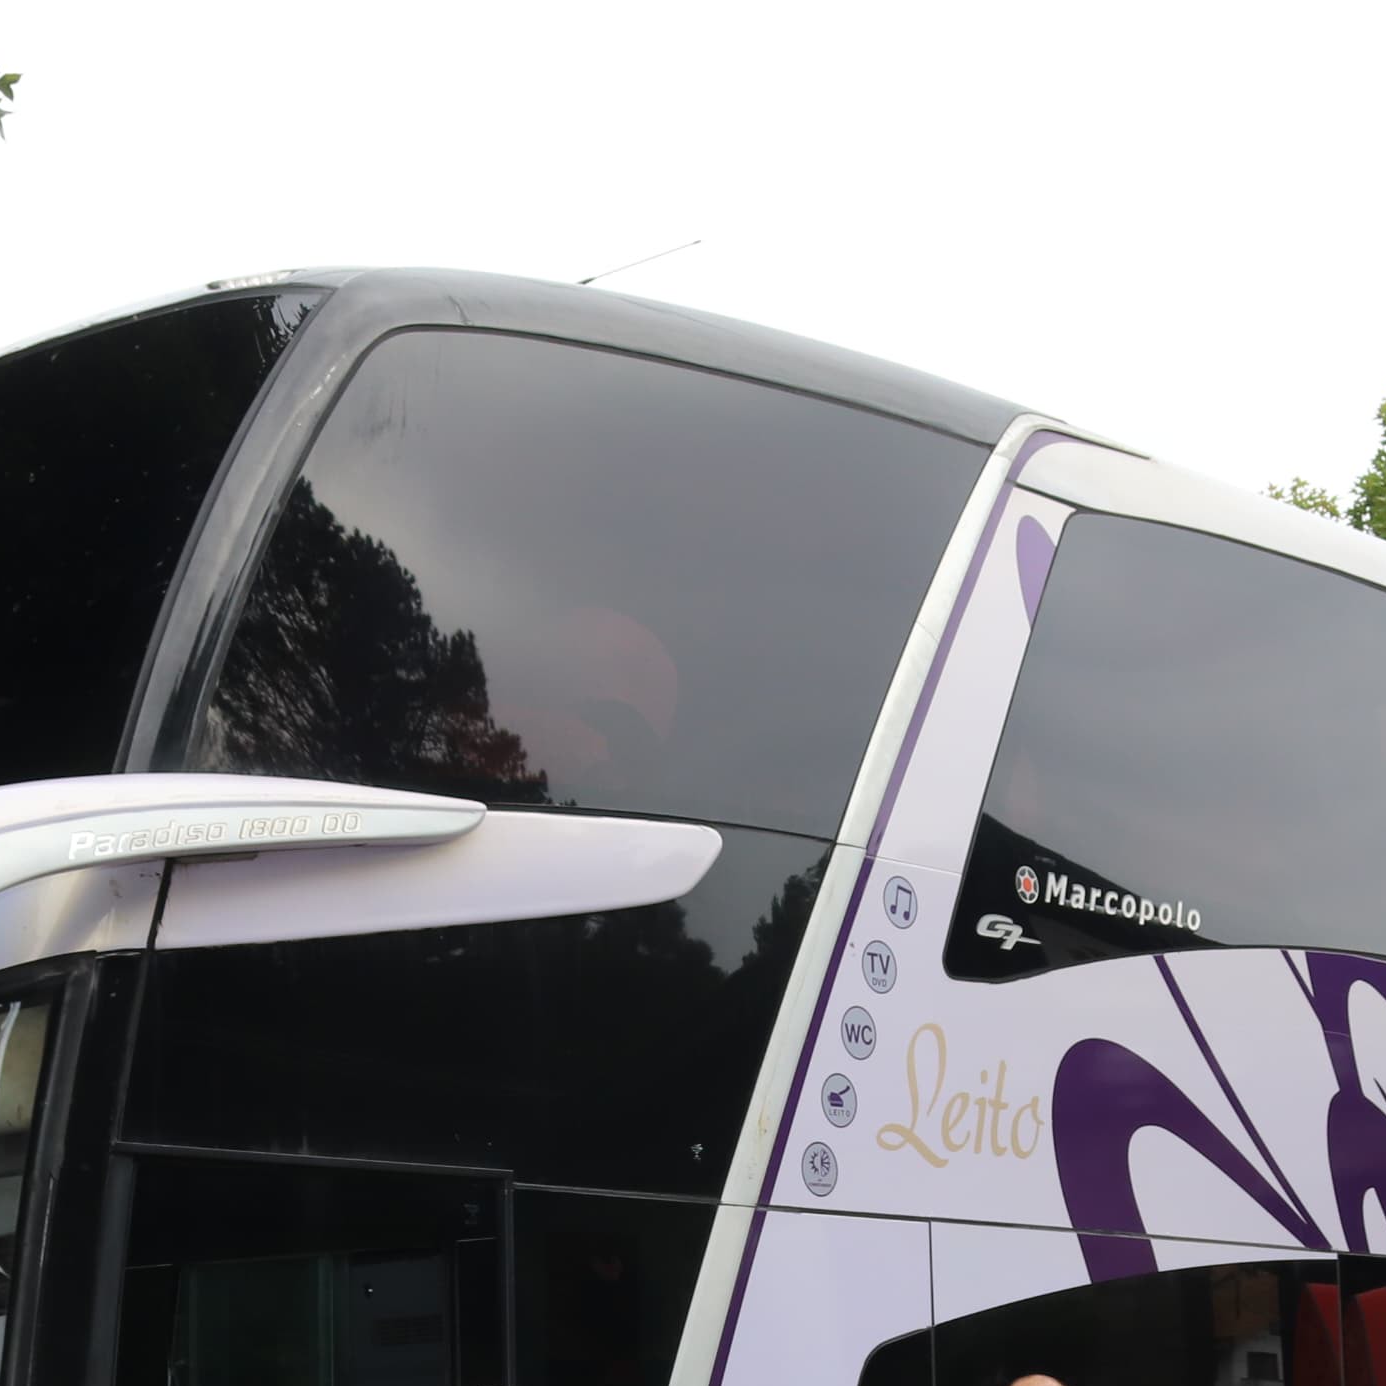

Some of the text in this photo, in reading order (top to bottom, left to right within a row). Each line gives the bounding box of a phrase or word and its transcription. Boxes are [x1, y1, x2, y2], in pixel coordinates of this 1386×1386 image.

[68, 820, 228, 860] Paradiso
[239, 815, 312, 840] 1800
[1044, 871, 1201, 932] Marcopolo
[867, 951, 890, 975] TV
[872, 977, 888, 988] DVD
[845, 1022, 874, 1046] WC
[876, 1023, 1044, 1168] Leito
[828, 1108, 851, 1117] LEITO
